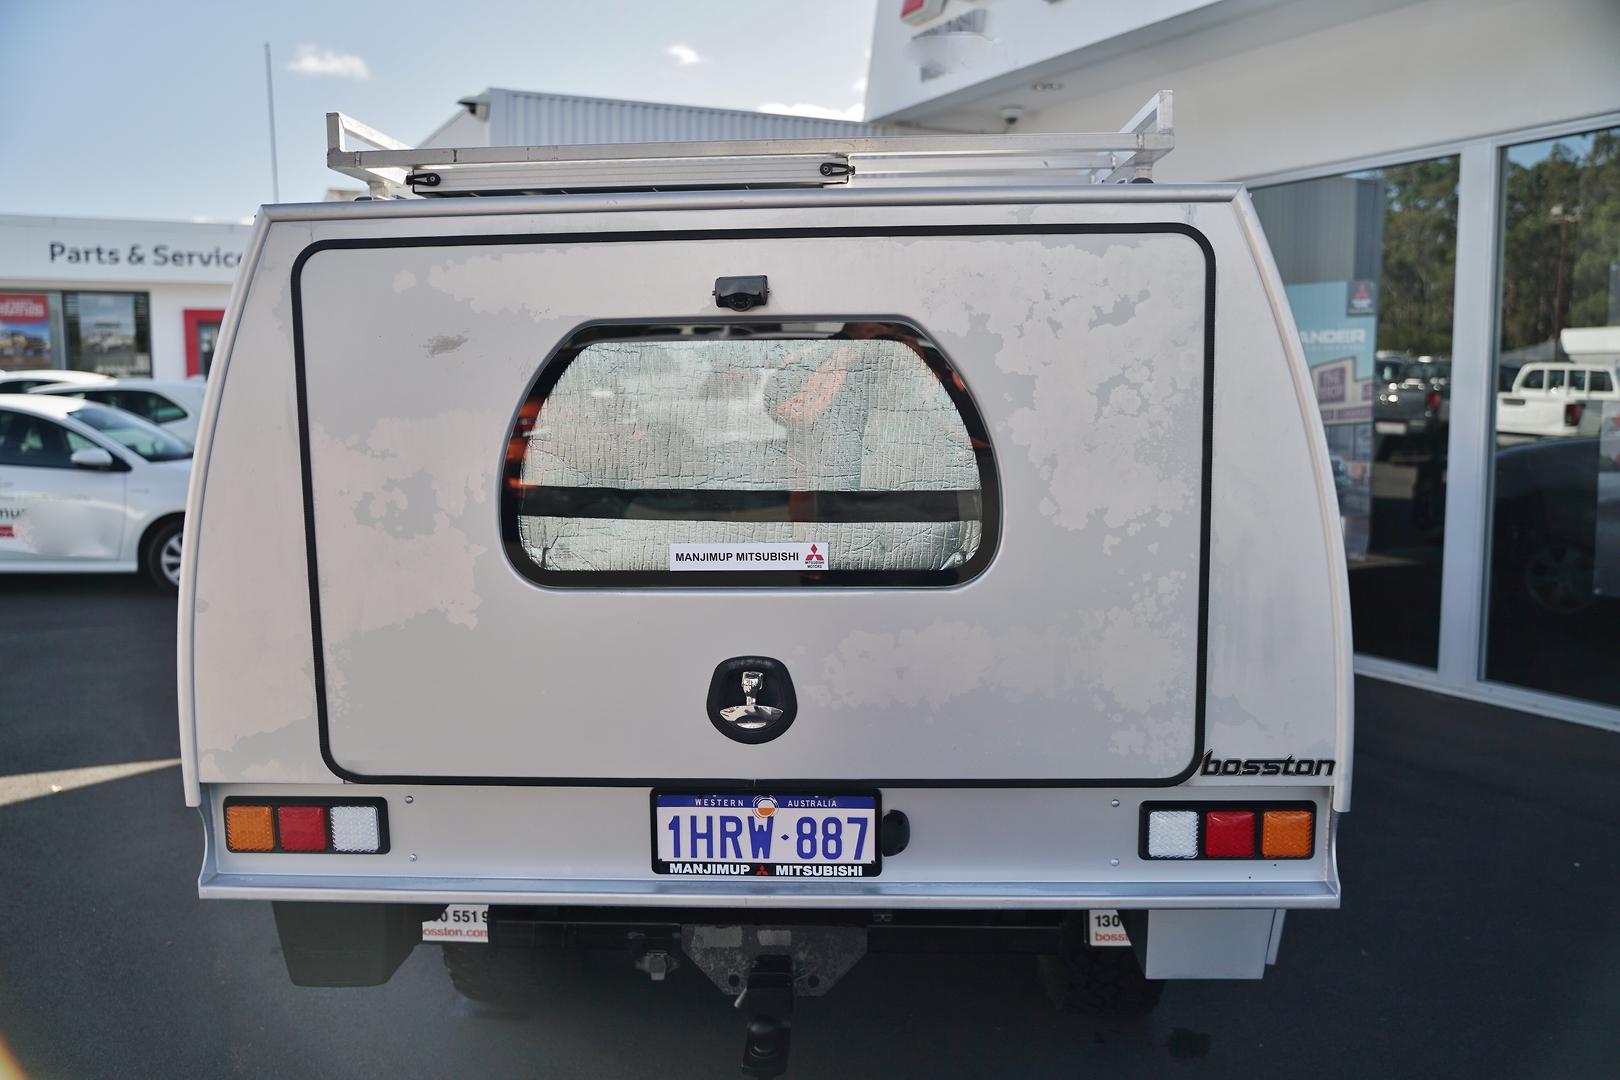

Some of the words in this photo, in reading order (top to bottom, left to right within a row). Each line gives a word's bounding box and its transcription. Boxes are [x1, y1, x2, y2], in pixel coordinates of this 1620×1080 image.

[49, 242, 120, 265] Parts
[127, 244, 146, 265] &
[675, 552, 733, 562] MANJIMUP
[736, 552, 799, 562] MITSUBISHI
[1200, 749, 1336, 776] bosston
[695, 798, 744, 807] WESTERN
[787, 799, 837, 808] AUSTRALIA
[669, 863, 750, 875] MANJIMUP
[775, 865, 863, 877] MITSUBISHI
